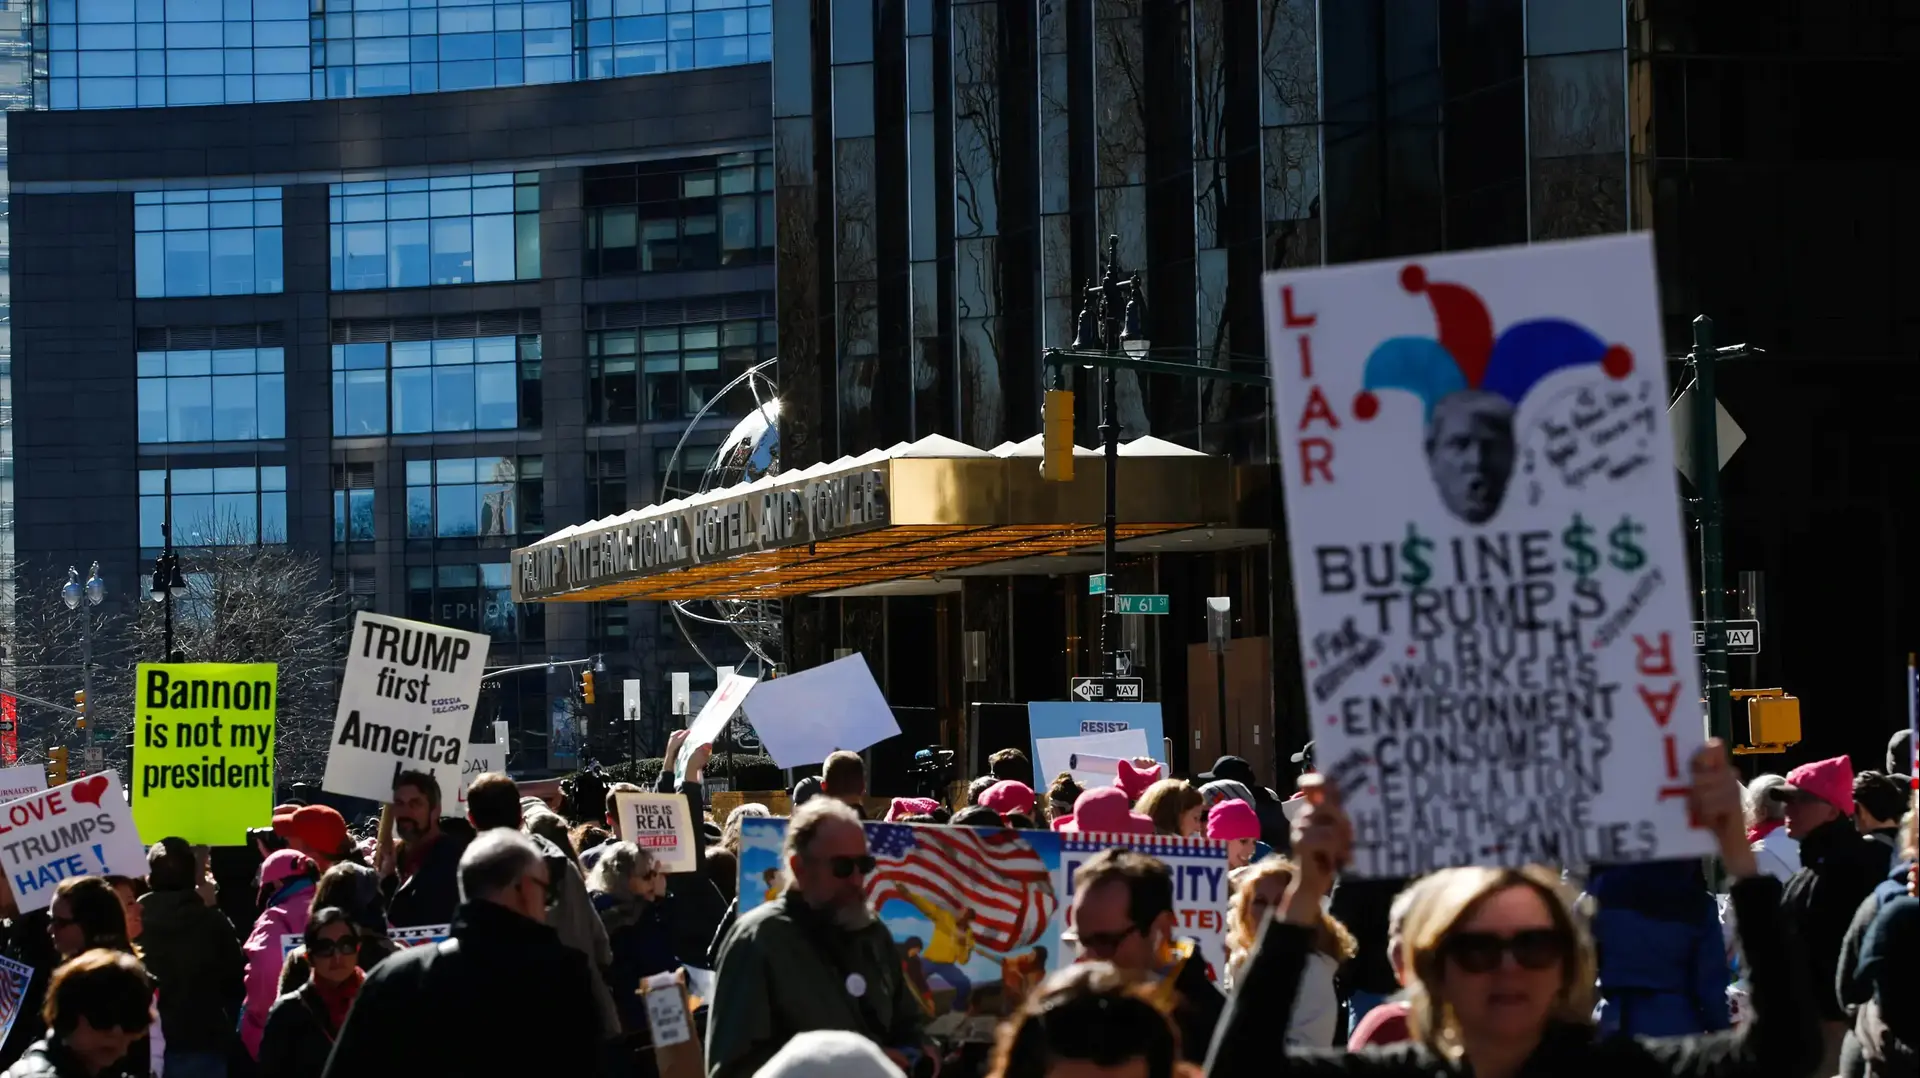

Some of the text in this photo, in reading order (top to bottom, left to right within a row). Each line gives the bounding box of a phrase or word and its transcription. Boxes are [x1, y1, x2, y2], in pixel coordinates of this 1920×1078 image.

[1281, 285, 1341, 486] LIAR
[518, 470, 884, 594] TRUMP INTERNATIONAL HOTEL AND TOWER
[1119, 597, 1167, 611] W 61 ST
[362, 620, 471, 673] TRUMP
[146, 670, 271, 710] Bannon
[376, 666, 430, 704] first
[1082, 685, 1102, 696] ONE
[1343, 683, 1621, 735] ENVIRONMENT
[145, 715, 271, 755] is not my
[338, 710, 461, 765] America
[1373, 727, 1613, 773] CONSUMERS
[143, 756, 270, 798] president
[634, 804, 673, 815] THIS IS
[636, 815, 675, 829] REAL
[3, 813, 116, 865] TRUMPS
